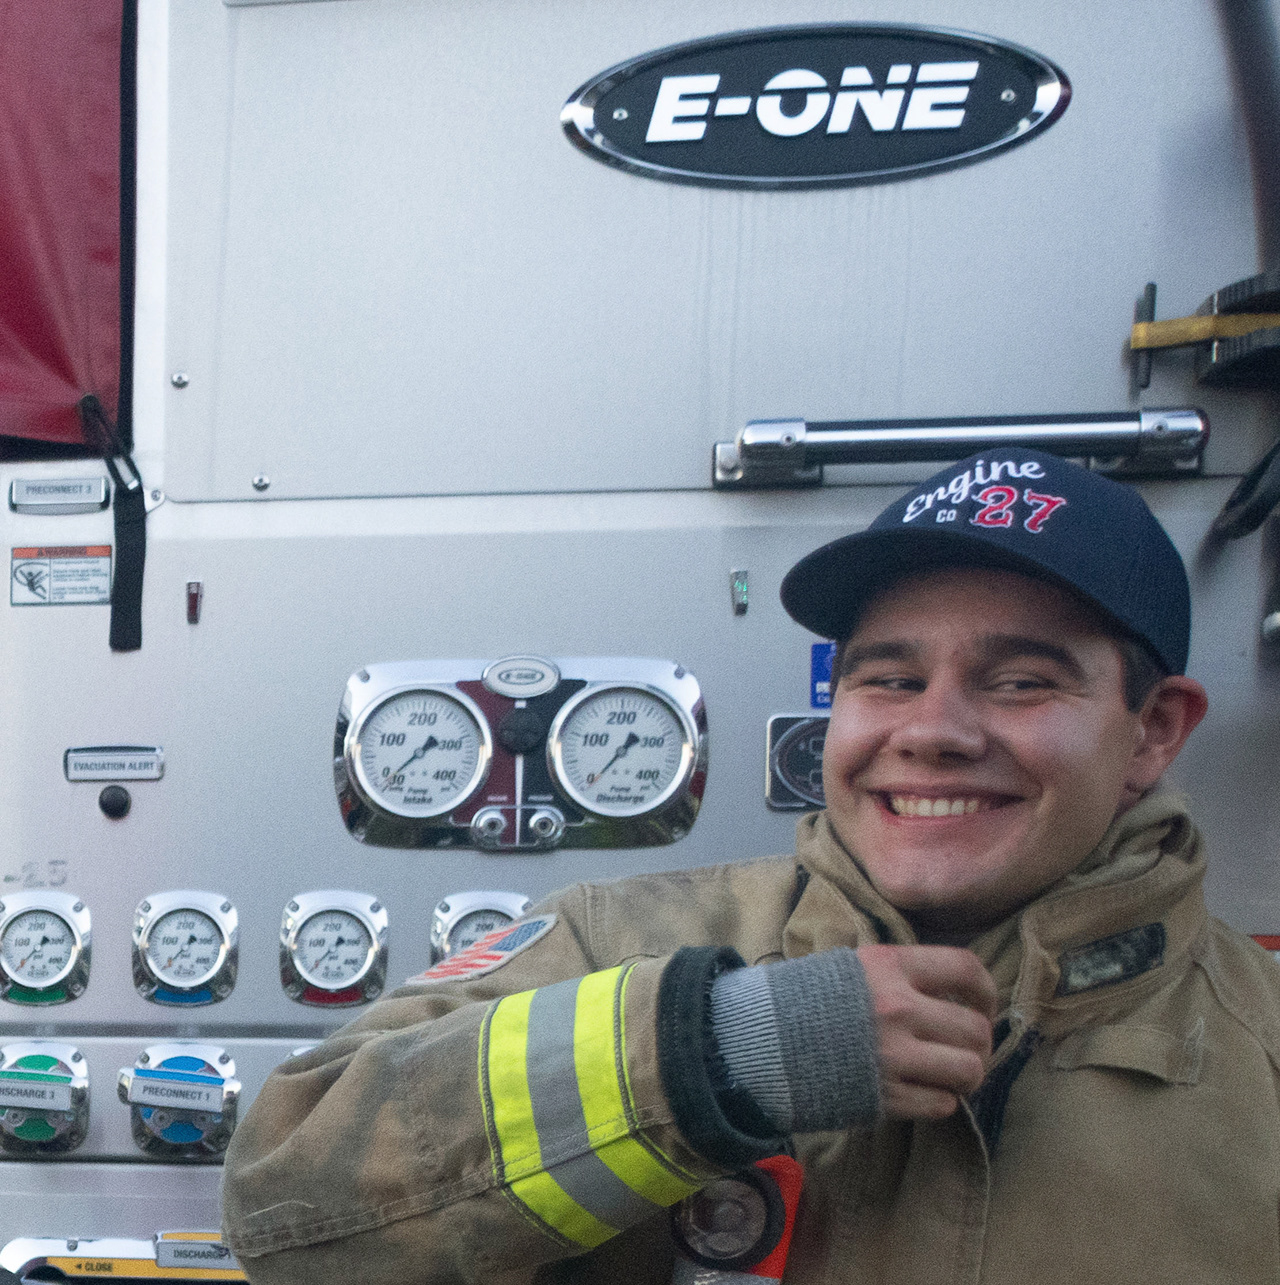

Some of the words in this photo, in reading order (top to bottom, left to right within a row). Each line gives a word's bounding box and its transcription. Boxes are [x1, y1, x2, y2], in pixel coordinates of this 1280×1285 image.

[645, 61, 980, 143] E-ONE
[26, 485, 83, 494] PRECONNECT
[902, 459, 1046, 523] Engine
[969, 485, 1068, 534] 27
[408, 712, 437, 726] 200
[606, 711, 637, 725] 200
[379, 733, 406, 746] 100
[439, 739, 462, 750] 300
[582, 733, 610, 747] 100
[641, 737, 665, 747] 300
[73, 762, 125, 771] EVACUATION
[128, 761, 154, 770] ALERT
[432, 770, 456, 780] 400
[635, 770, 660, 780] 400
[27, 922, 46, 931] 200
[176, 922, 195, 930] 200
[323, 923, 341, 932] 200
[14, 938, 30, 947] 100
[161, 937, 178, 946] 100
[309, 938, 325, 947] 100
[142, 1085, 202, 1100] PRECONNECT
[85, 1262, 113, 1272] CLOSE
